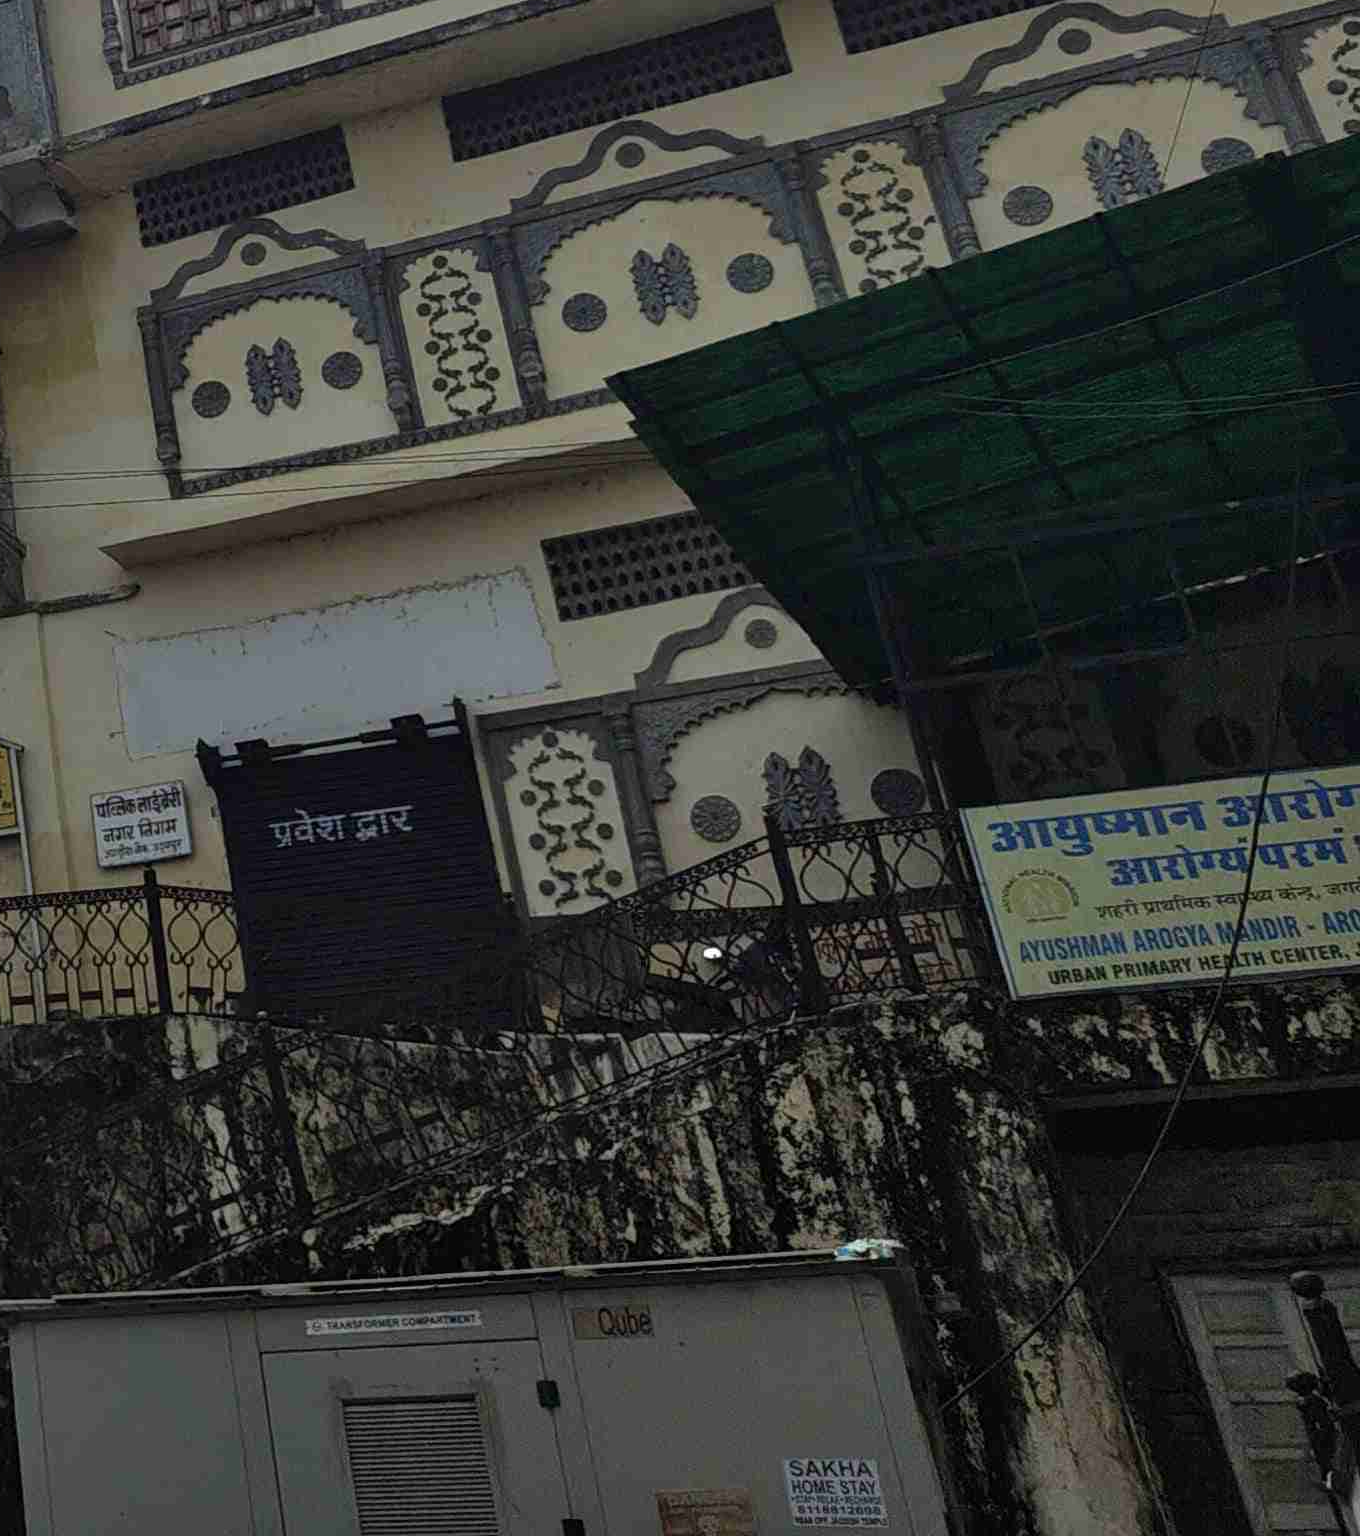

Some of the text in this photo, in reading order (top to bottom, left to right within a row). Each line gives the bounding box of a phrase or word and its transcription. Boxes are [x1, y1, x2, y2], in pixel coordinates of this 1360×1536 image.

[267, 804, 415, 848] प्रवेश द्वार
[987, 799, 1208, 857] आयुष्मान
[1142, 896, 1212, 917] प्राथमिक
[1019, 931, 1128, 963] AYUSHMAN
[1133, 923, 1212, 953] AROGYA
[1218, 914, 1301, 944] MANDIR
[1048, 964, 1107, 985] URBAN
[1113, 957, 1192, 979] PRIMARY
[1198, 951, 1265, 972] HEALTH
[1270, 944, 1350, 965] CENTER,
[597, 1306, 654, 1337] Qube
[789, 1459, 873, 1478] SAKHA
[791, 1479, 876, 1495] HOME STAY
